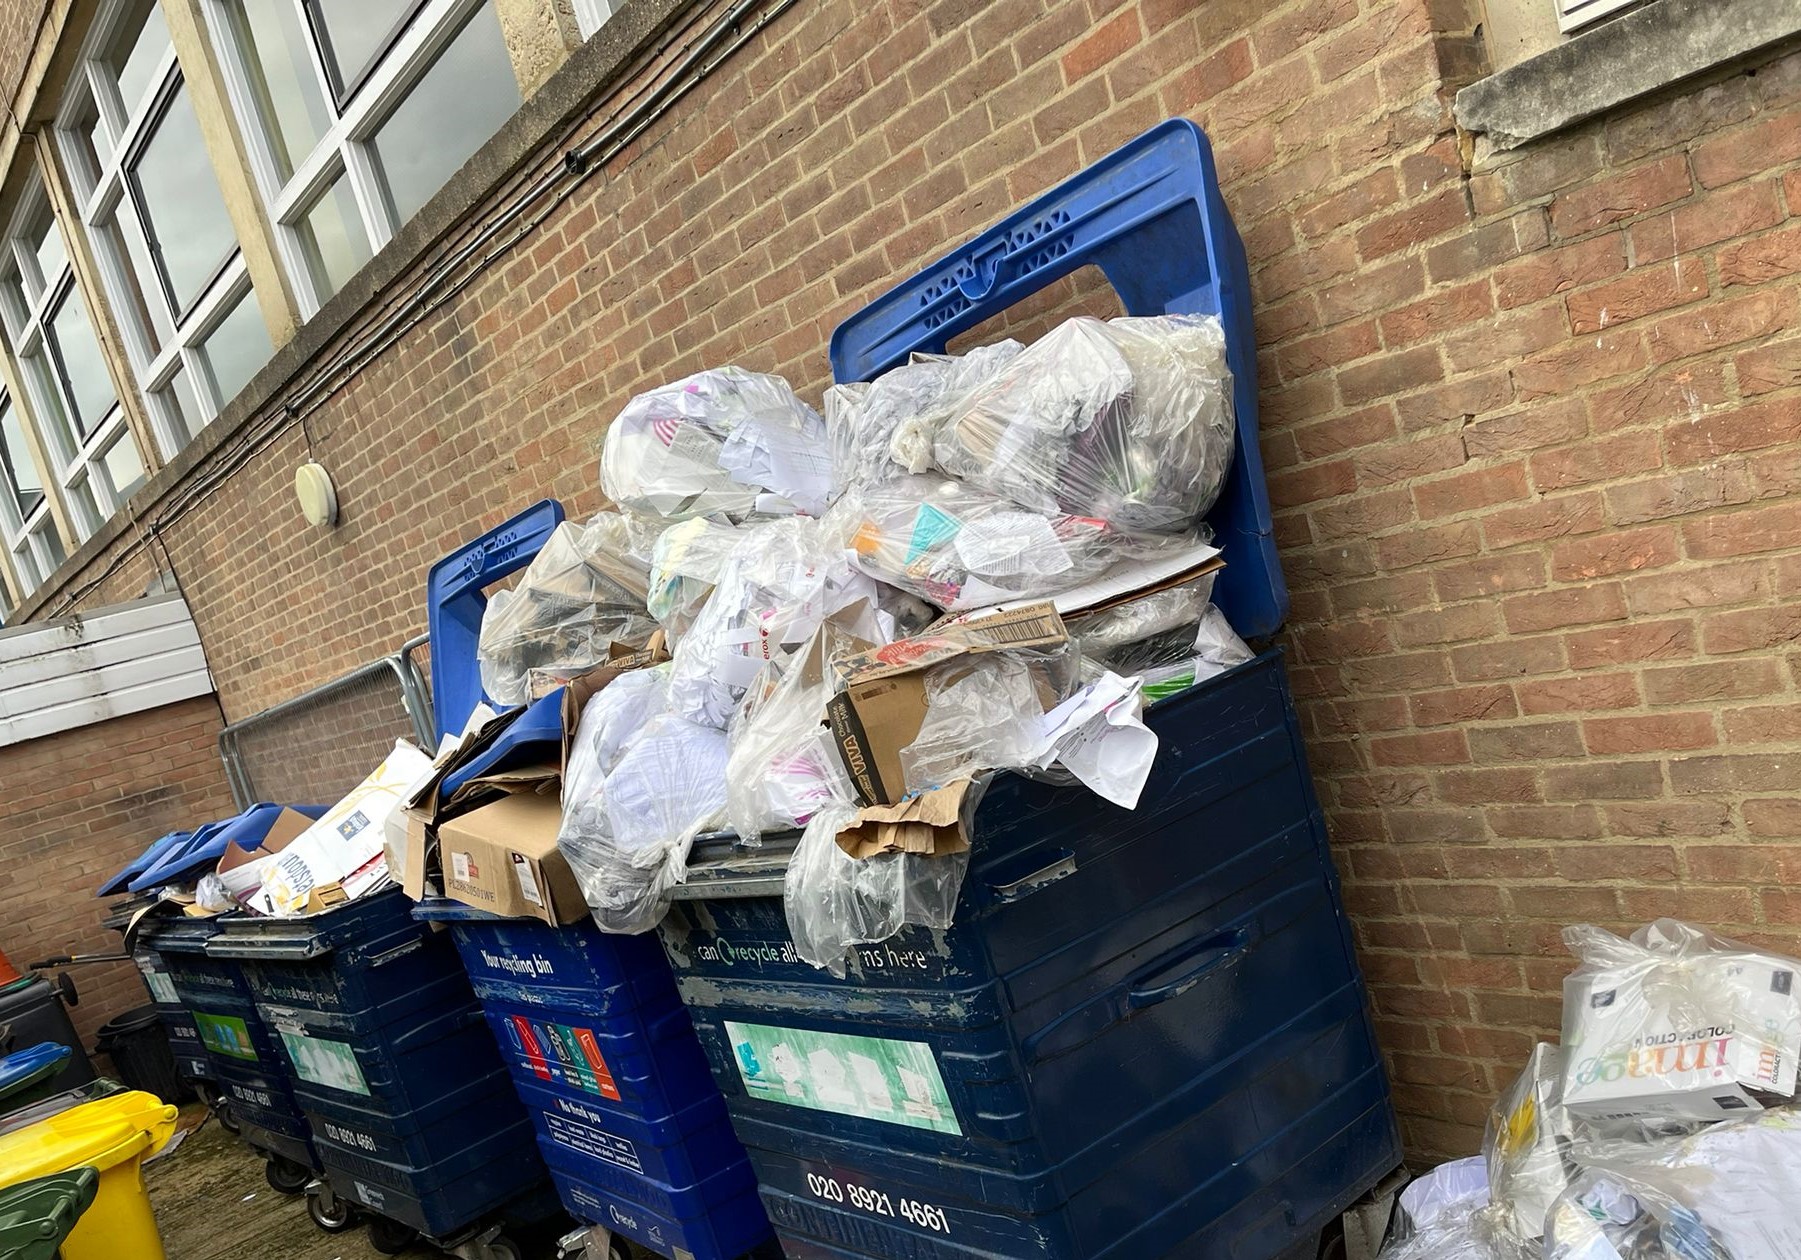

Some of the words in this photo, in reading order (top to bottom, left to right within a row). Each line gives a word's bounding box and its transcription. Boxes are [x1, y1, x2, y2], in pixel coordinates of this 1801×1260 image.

[762, 639, 770, 660] erox
[843, 734, 867, 776] VIVA
[481, 950, 500, 968] Your
[499, 955, 536, 978] recycling
[532, 954, 553, 974] bin
[698, 945, 719, 961] can
[735, 941, 779, 967] recycle
[884, 943, 927, 969] here
[559, 1098, 571, 1113] No
[568, 1102, 590, 1119] thank
[587, 1110, 601, 1124] you
[325, 1123, 339, 1140] 020
[338, 1127, 357, 1146] 8921
[356, 1133, 377, 1152] 4661
[807, 1172, 843, 1203] 020
[847, 1183, 895, 1217] 8921
[900, 1198, 951, 1234] 4661
